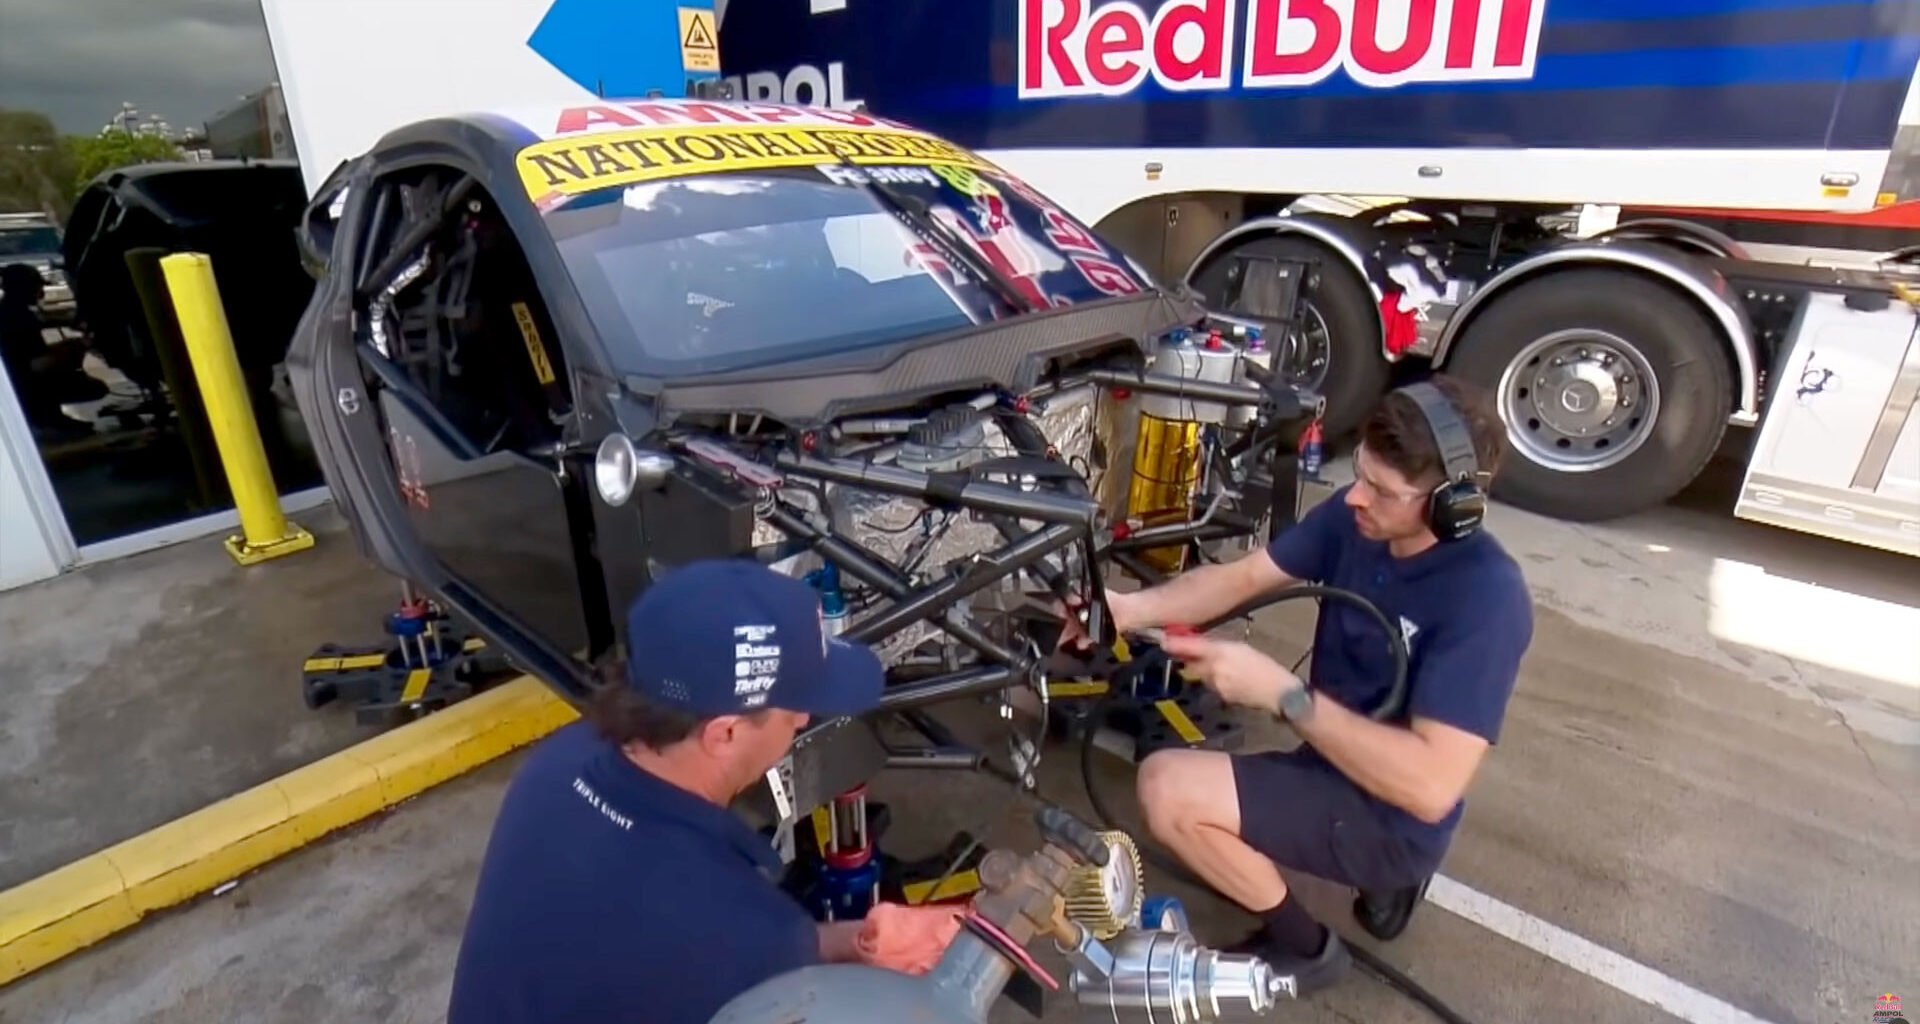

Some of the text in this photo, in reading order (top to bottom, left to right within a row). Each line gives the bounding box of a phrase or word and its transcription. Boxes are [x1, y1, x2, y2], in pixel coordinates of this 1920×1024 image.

[1024, 0, 1532, 90] Red Bull
[527, 131, 828, 186] NATIONAL
[601, 802, 634, 831] EIGHT
